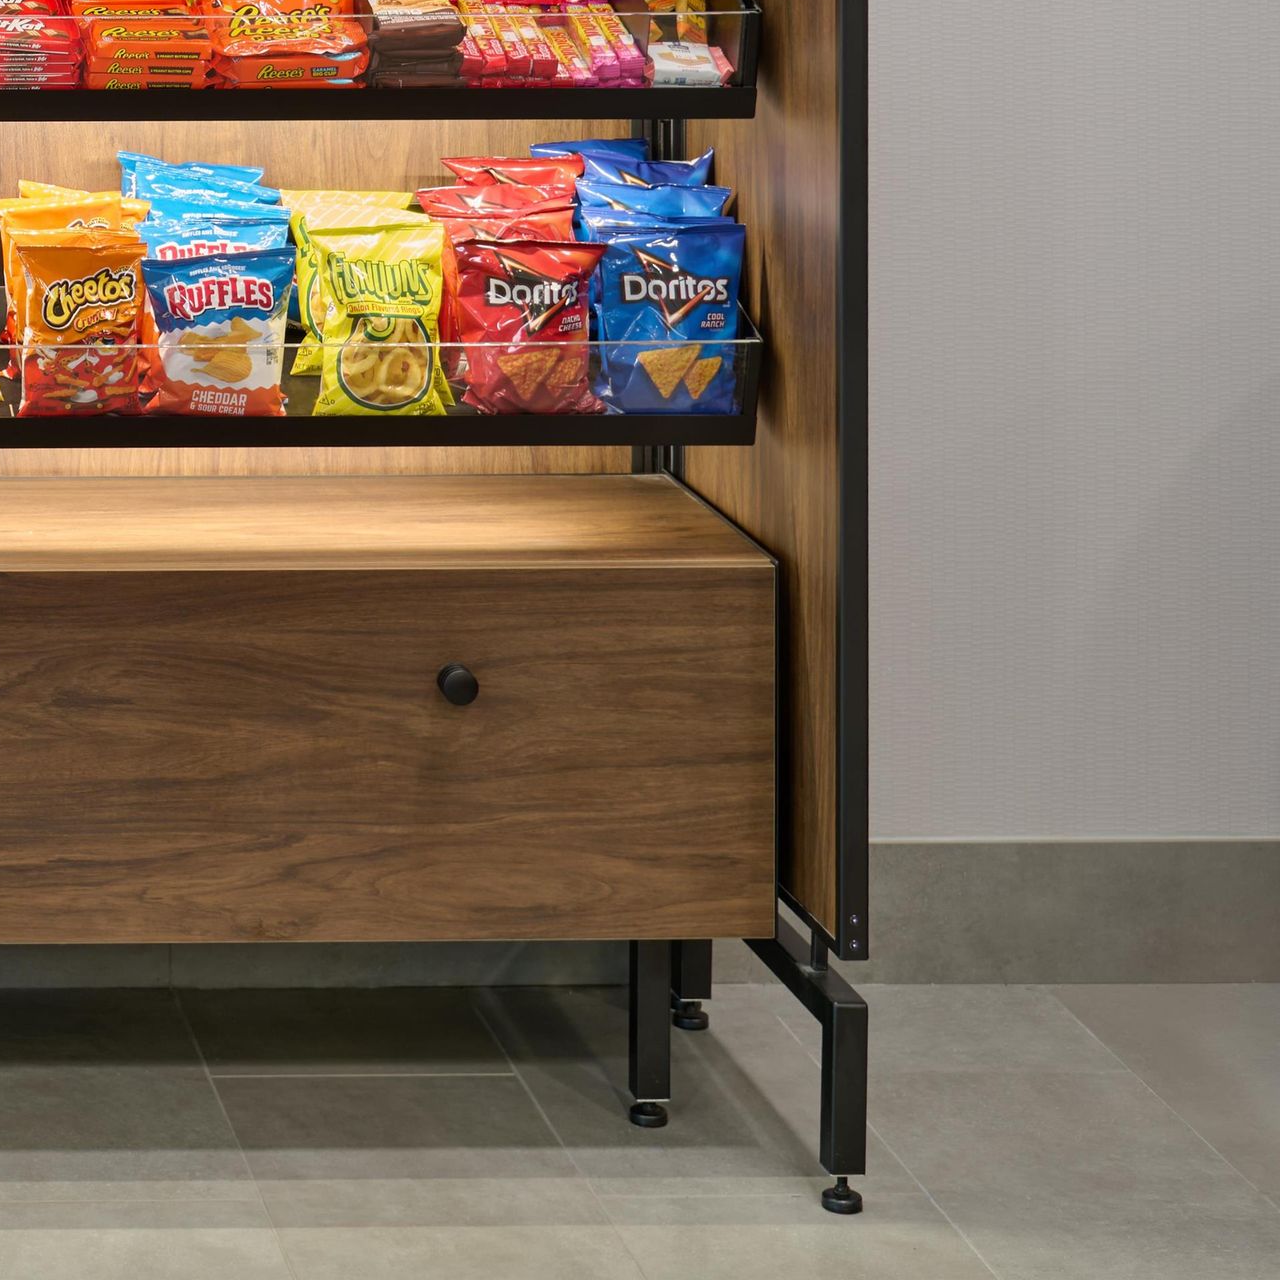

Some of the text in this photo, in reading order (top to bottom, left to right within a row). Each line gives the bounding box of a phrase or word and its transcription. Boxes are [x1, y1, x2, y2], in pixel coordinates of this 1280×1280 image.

[114, 49, 150, 59] Reese's
[108, 63, 143, 74] Reese's
[257, 65, 304, 80] Reese's
[328, 252, 433, 306] FUNYUNS
[489, 277, 579, 305] Doritos
[624, 275, 728, 301] Doritos
[43, 268, 136, 331] Cheetos
[165, 276, 274, 320] RUFFLES
[348, 303, 421, 315] Onion Flavored Rings
[561, 314, 581, 324] NACHO
[707, 313, 725, 321] COOL
[558, 322, 583, 333] CHEESE
[701, 320, 725, 329] RANCH
[192, 390, 247, 406] CHEDDAR
[197, 404, 218, 413] SOUR
[220, 406, 245, 415] CREAM
